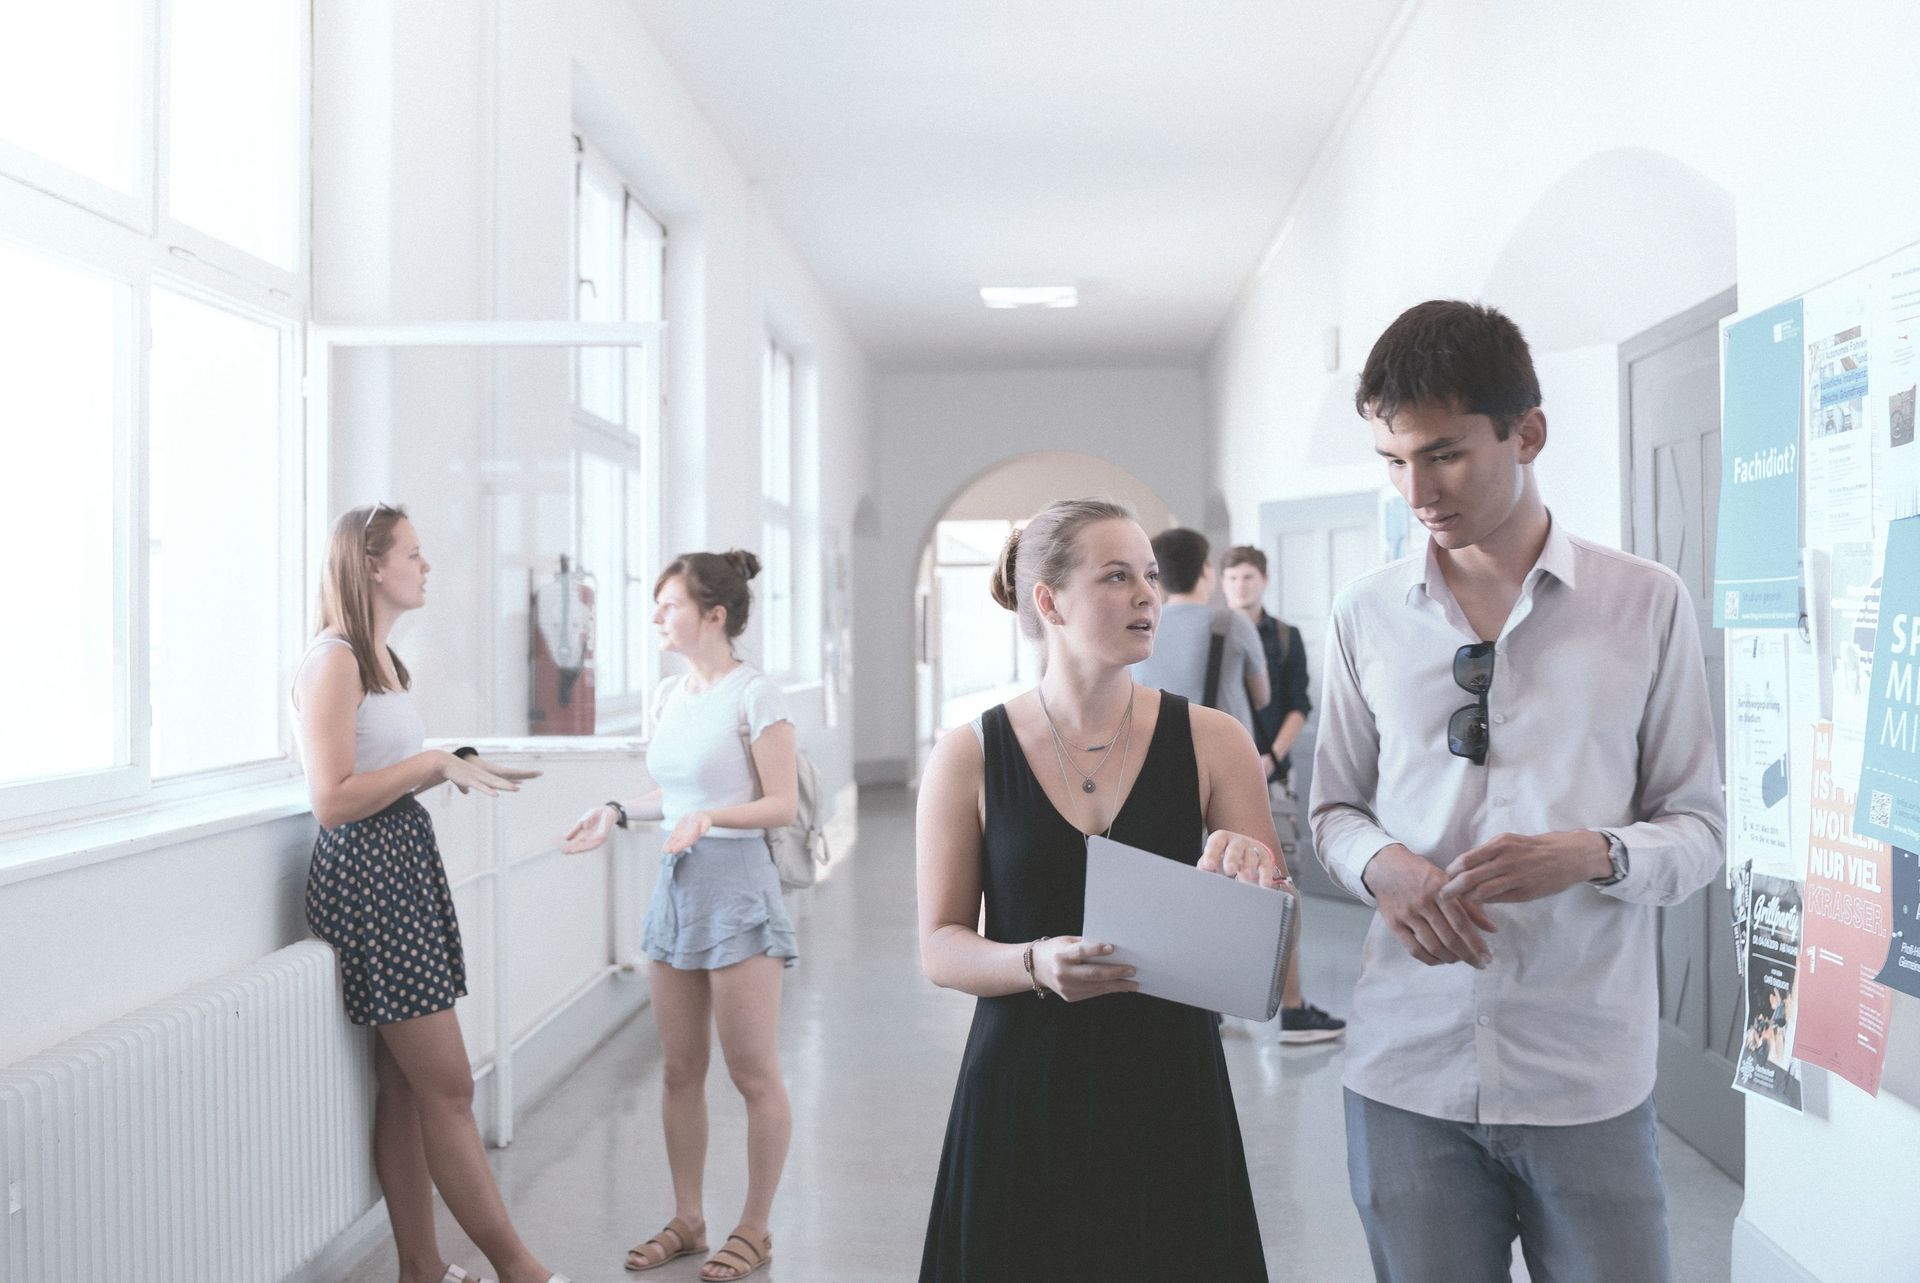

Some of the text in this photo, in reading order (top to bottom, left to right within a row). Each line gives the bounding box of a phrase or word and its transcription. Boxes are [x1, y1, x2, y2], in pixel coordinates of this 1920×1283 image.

[1734, 443, 1796, 484] Fachidiot?
[1811, 847, 1844, 882] NUR
[1848, 855, 1881, 894] VIEL
[1753, 894, 1800, 942] Grillparty
[1807, 883, 1887, 938] KRASSER.
